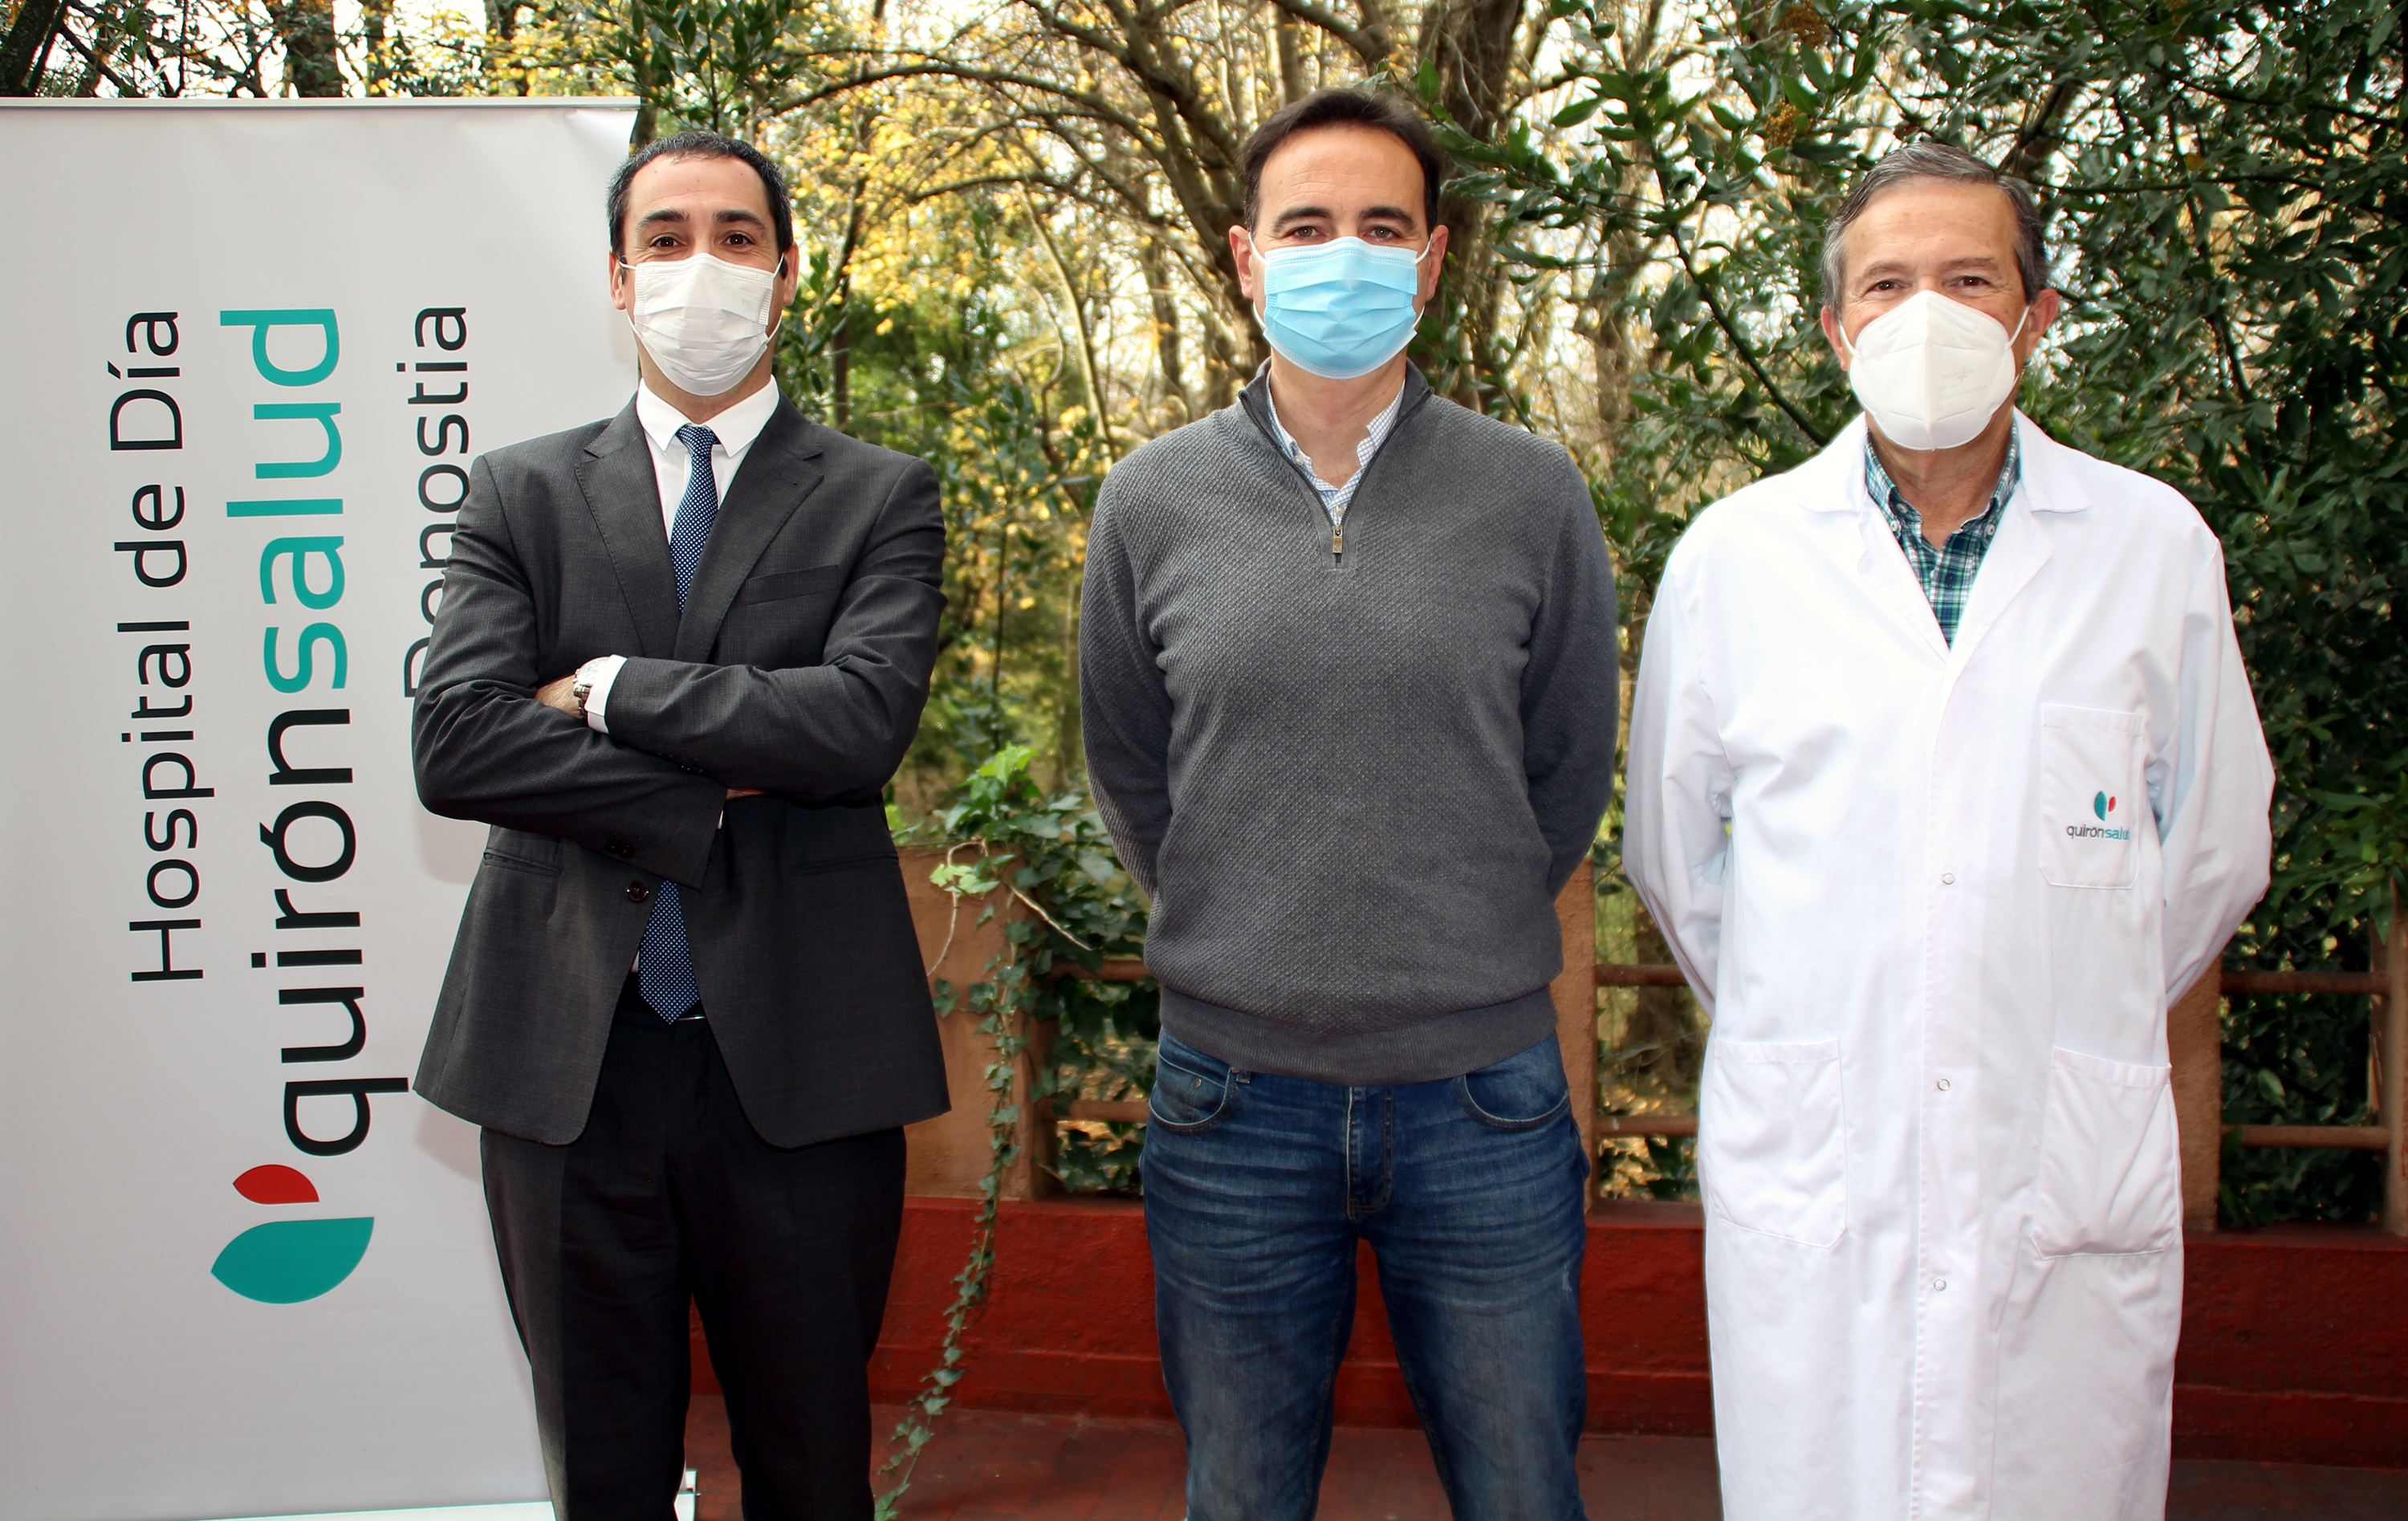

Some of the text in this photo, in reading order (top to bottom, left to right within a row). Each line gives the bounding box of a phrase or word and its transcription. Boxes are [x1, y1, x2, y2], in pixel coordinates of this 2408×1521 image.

[107, 311, 214, 982] Hospital de Día
[219, 308, 409, 1157] quirónsalud
